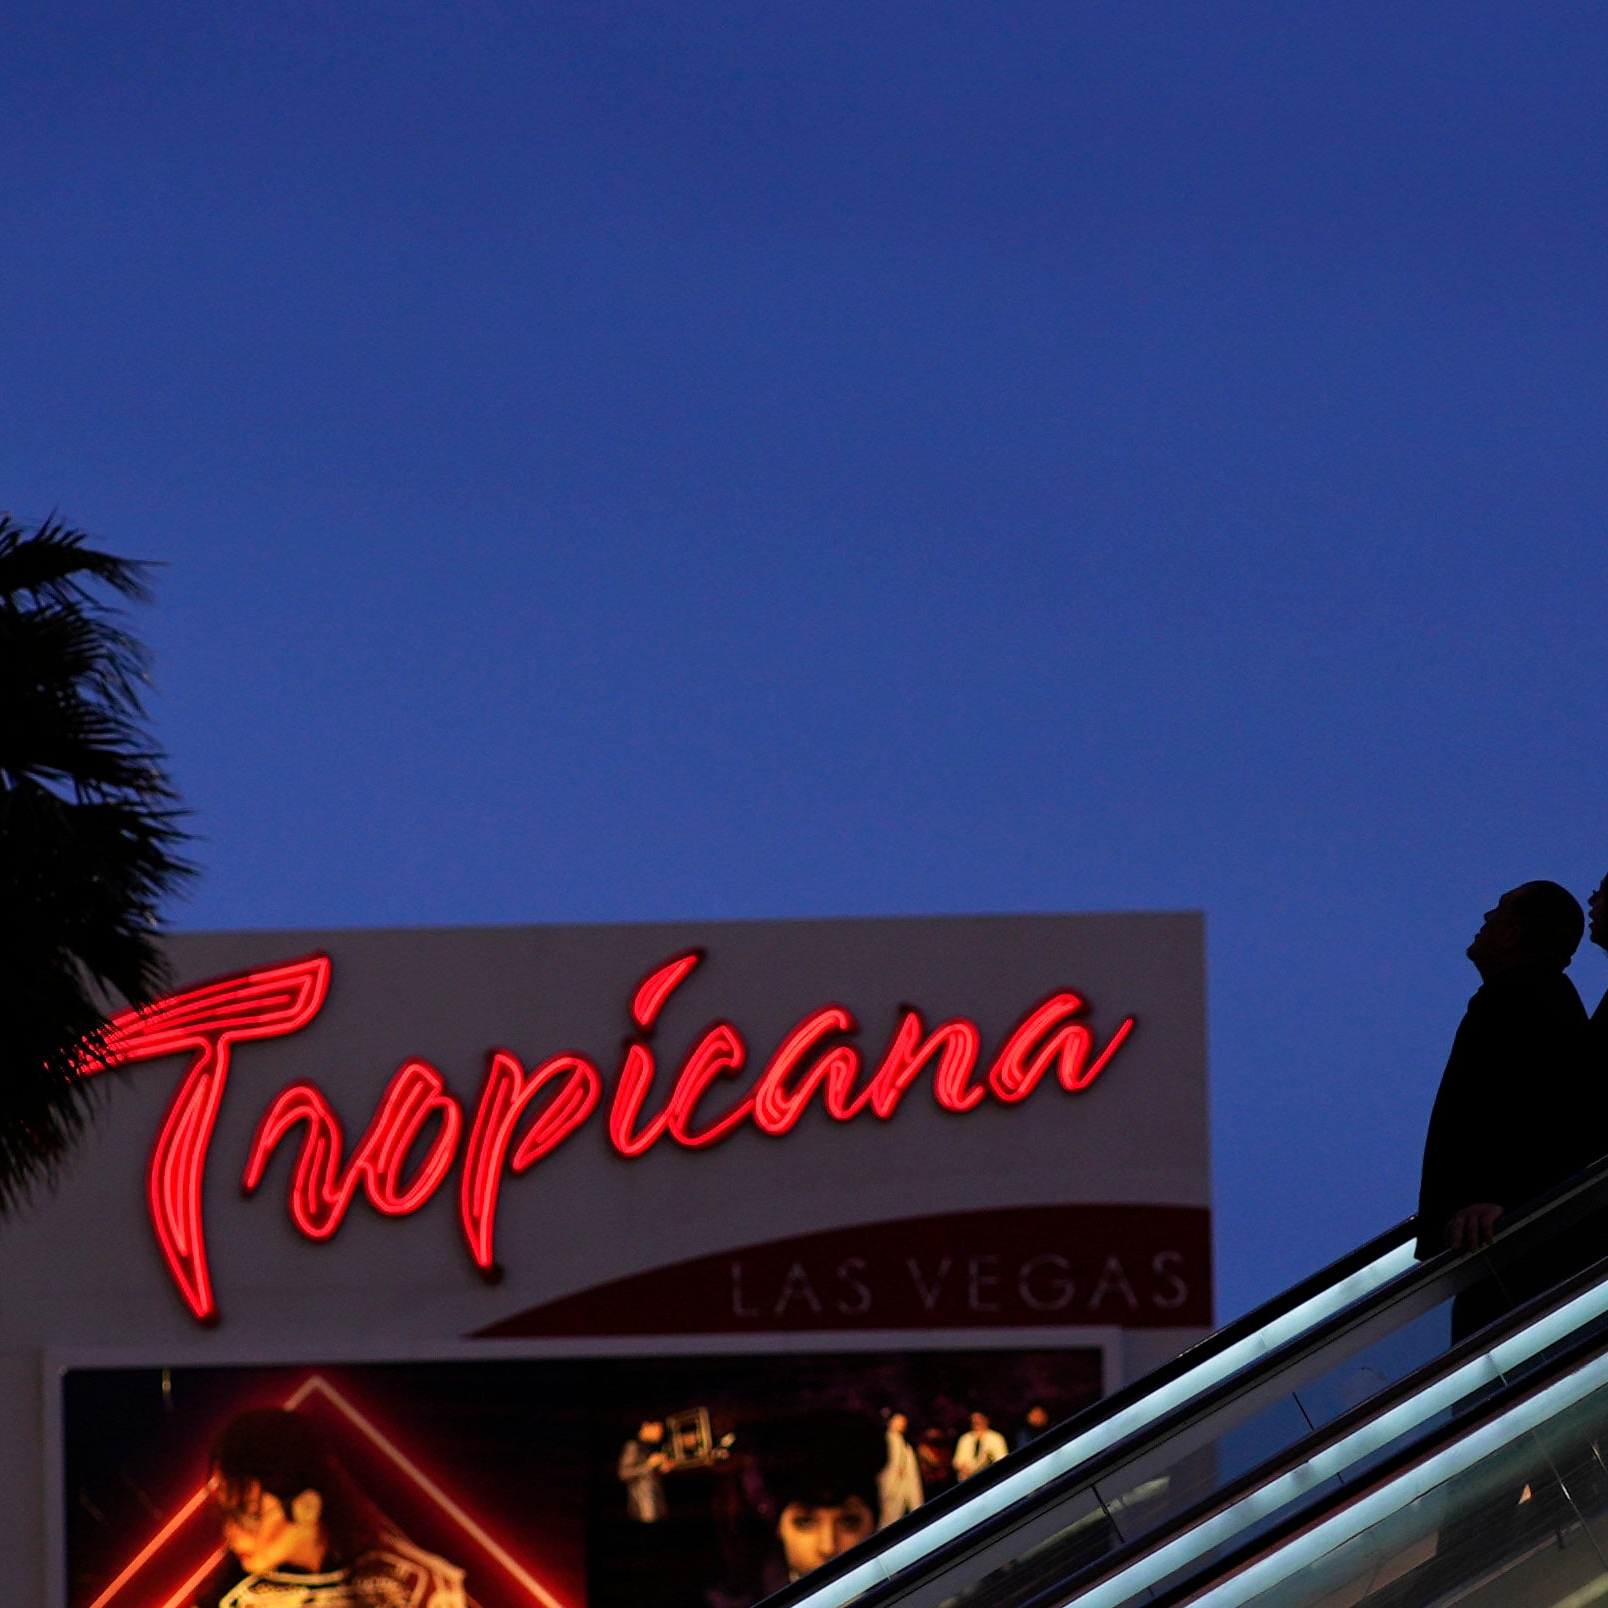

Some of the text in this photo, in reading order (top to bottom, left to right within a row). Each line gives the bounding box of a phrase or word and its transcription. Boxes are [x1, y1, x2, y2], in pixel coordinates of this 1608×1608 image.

[55, 950, 1137, 1323] Tropicana
[730, 1249, 1191, 1319] LAS VEGAS
